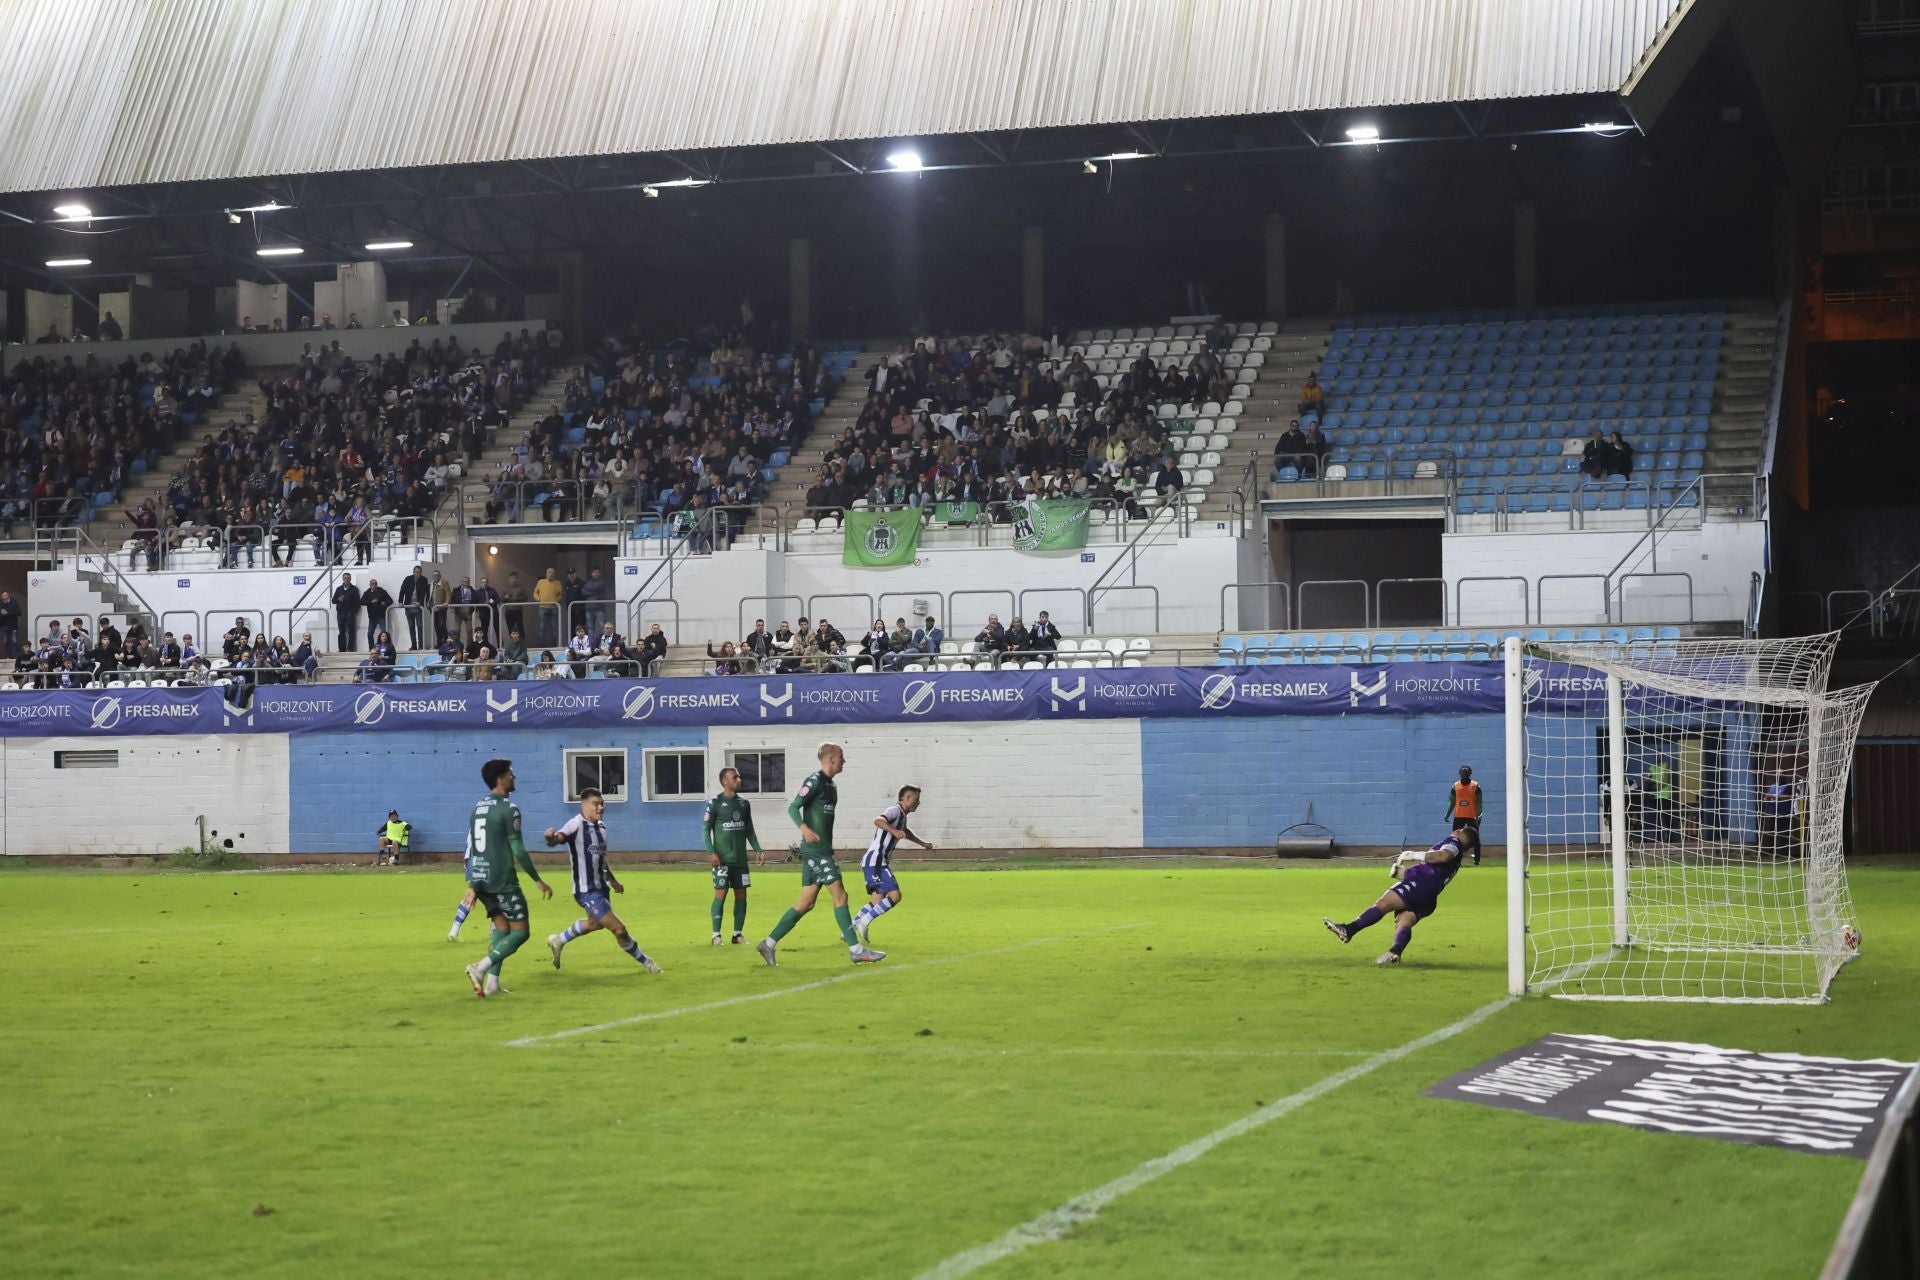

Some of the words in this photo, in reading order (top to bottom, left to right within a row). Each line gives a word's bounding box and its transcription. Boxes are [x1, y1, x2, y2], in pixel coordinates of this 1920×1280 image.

[1093, 683, 1177, 698] HORIZONTE
[1241, 682, 1328, 697] FRESAMEX
[1395, 678, 1481, 692] HORIZONTE
[525, 694, 600, 710] HORIZONTE
[659, 694, 740, 708] FRESAMEX
[800, 689, 880, 704] HORIZONTE
[941, 688, 1024, 703] FRESAMEX
[2, 705, 71, 719] HORIZONTE
[126, 704, 199, 718] FRESAMEX
[260, 700, 334, 714] HORIZONTE
[390, 699, 467, 713] FRESAMEX
[474, 818, 486, 853] 5
